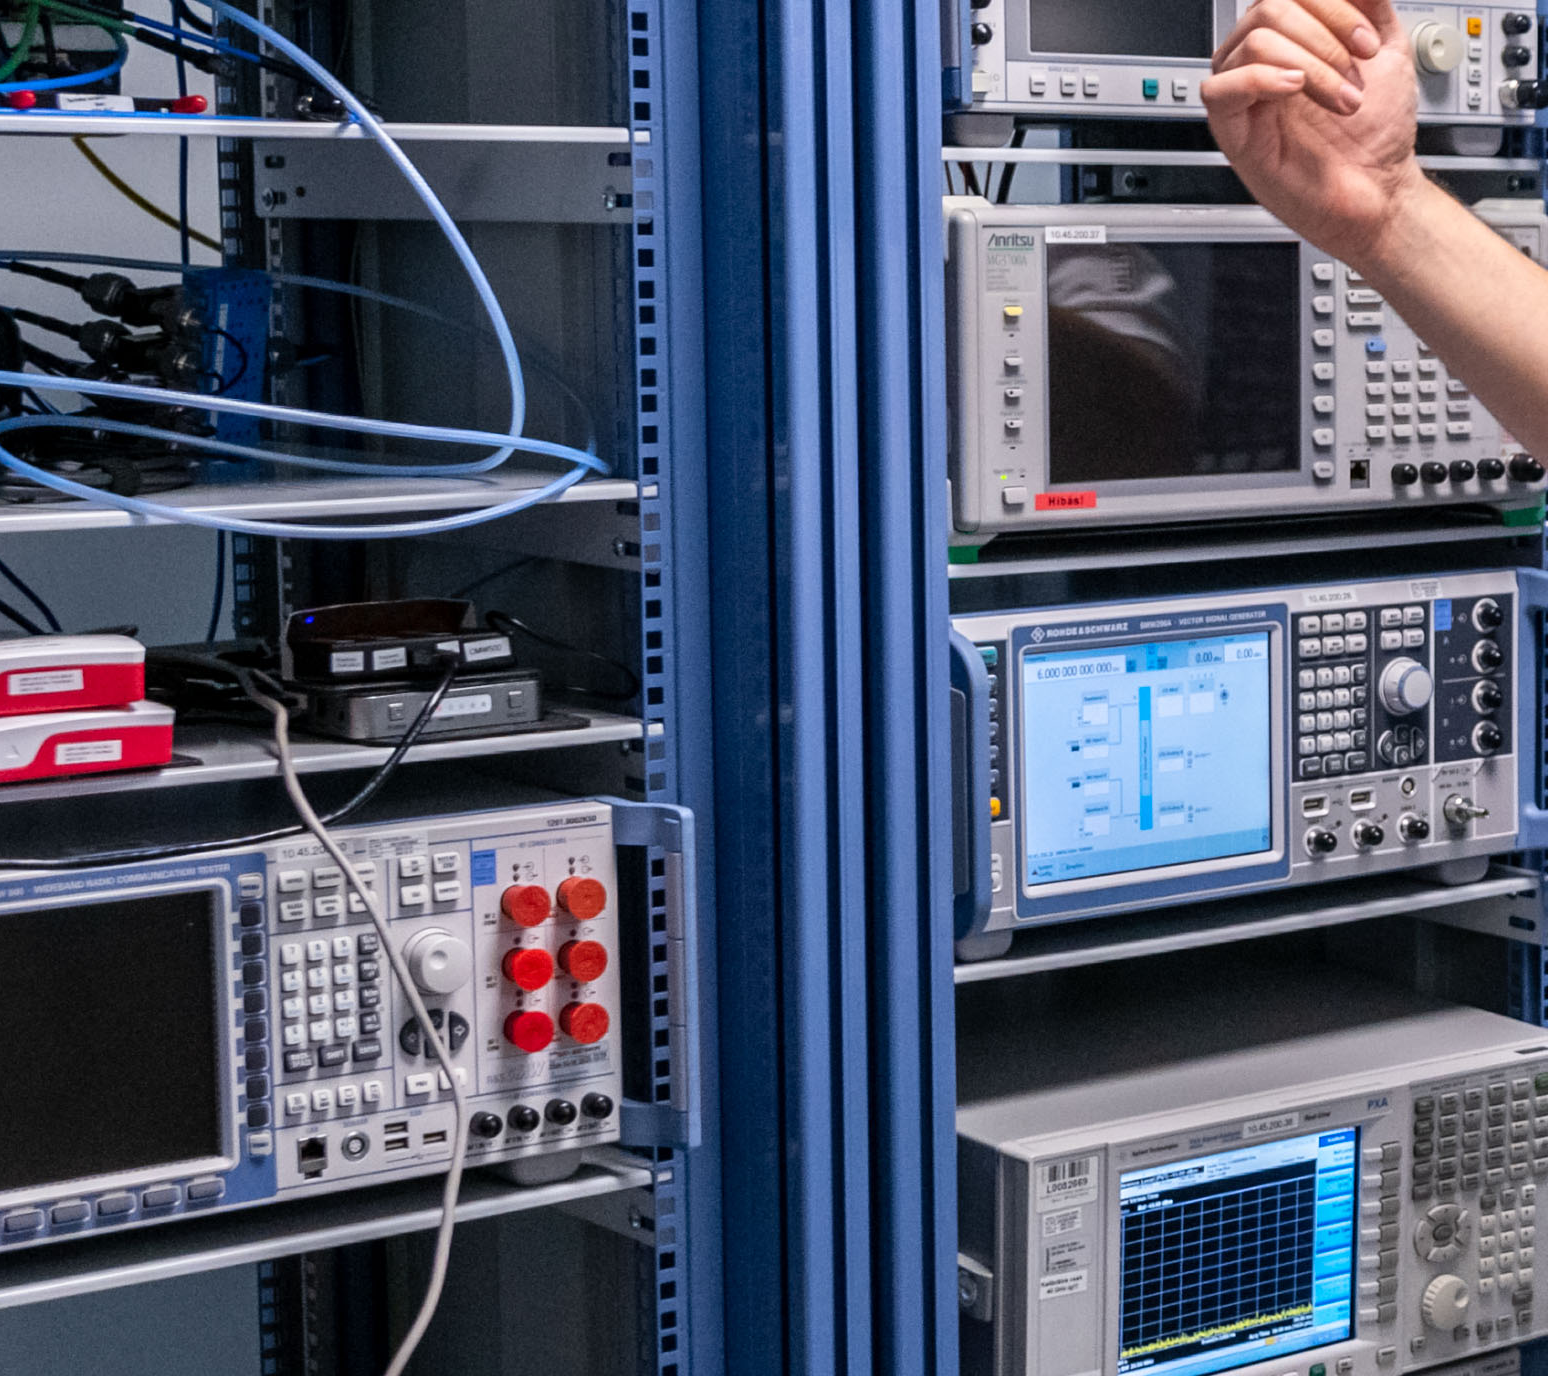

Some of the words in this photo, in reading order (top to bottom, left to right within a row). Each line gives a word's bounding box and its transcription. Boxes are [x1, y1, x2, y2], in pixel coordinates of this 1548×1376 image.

[987, 232, 1034, 247] Anritsu
[1048, 495, 1084, 506] Hibás!
[1367, 1096, 1389, 1111] PXA
